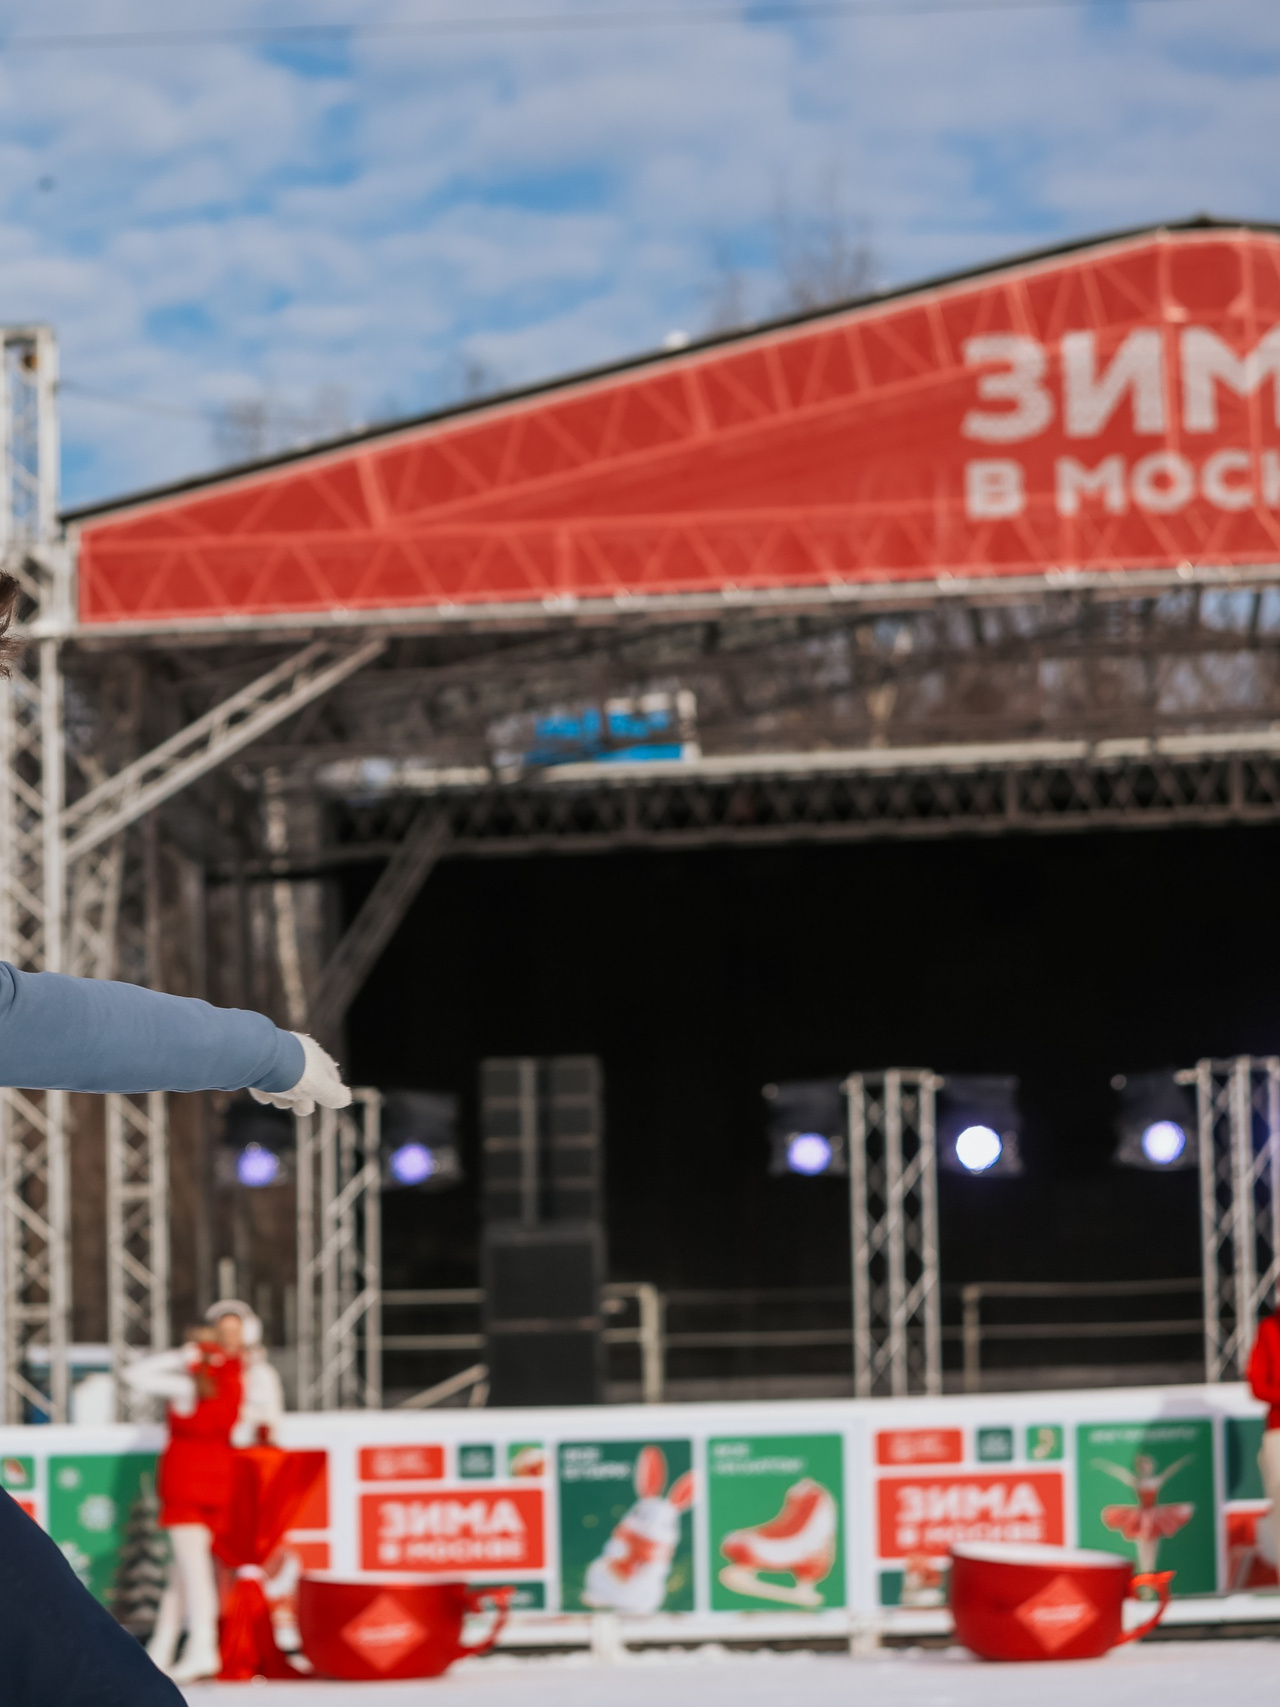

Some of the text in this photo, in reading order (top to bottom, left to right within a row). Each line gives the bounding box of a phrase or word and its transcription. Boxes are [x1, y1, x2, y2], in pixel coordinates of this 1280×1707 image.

[964, 456, 1026, 521] В
[377, 1498, 527, 1541] ЗИМА
[894, 1482, 1045, 1524] ЗИМА
